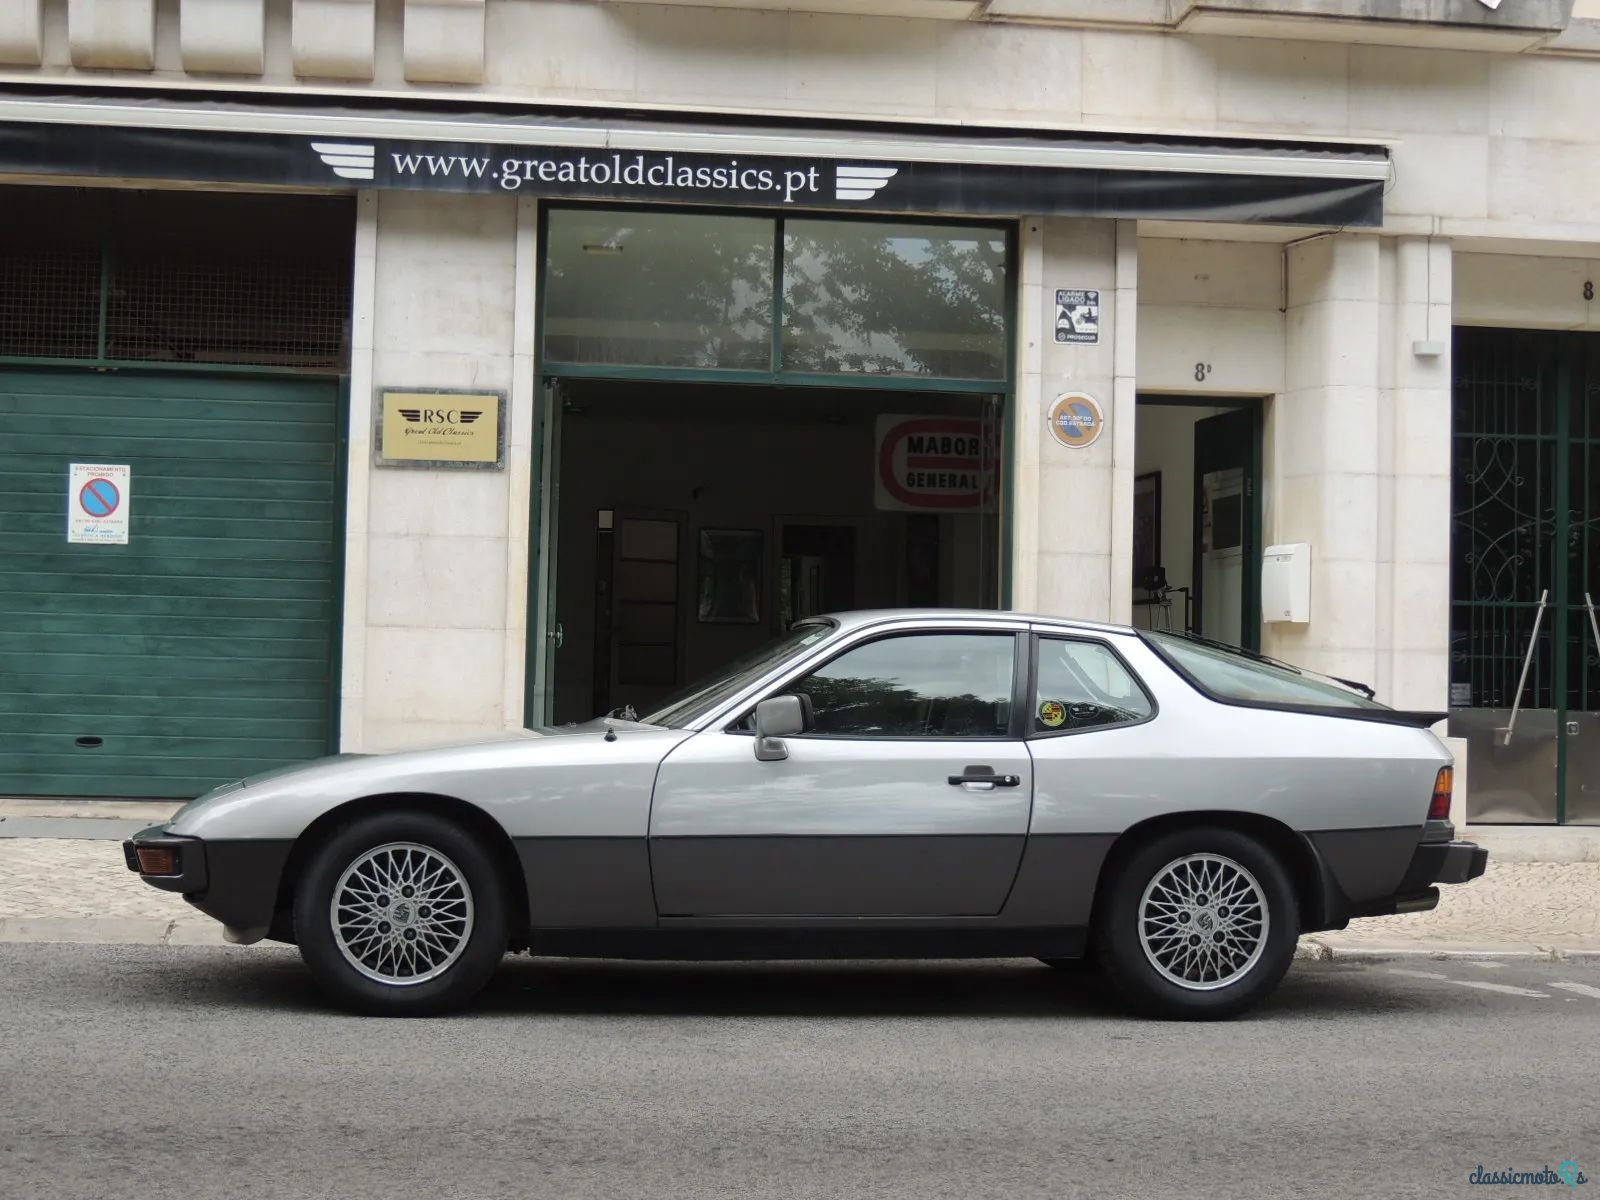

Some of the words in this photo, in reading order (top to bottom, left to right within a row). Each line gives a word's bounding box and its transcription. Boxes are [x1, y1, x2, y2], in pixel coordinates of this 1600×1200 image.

[391, 150, 821, 202] www.greatoldclassics.pt
[1583, 280, 1594, 301] 8
[423, 409, 459, 424] RSC
[907, 435, 980, 456] MABOR
[906, 472, 979, 489] GENERAL
